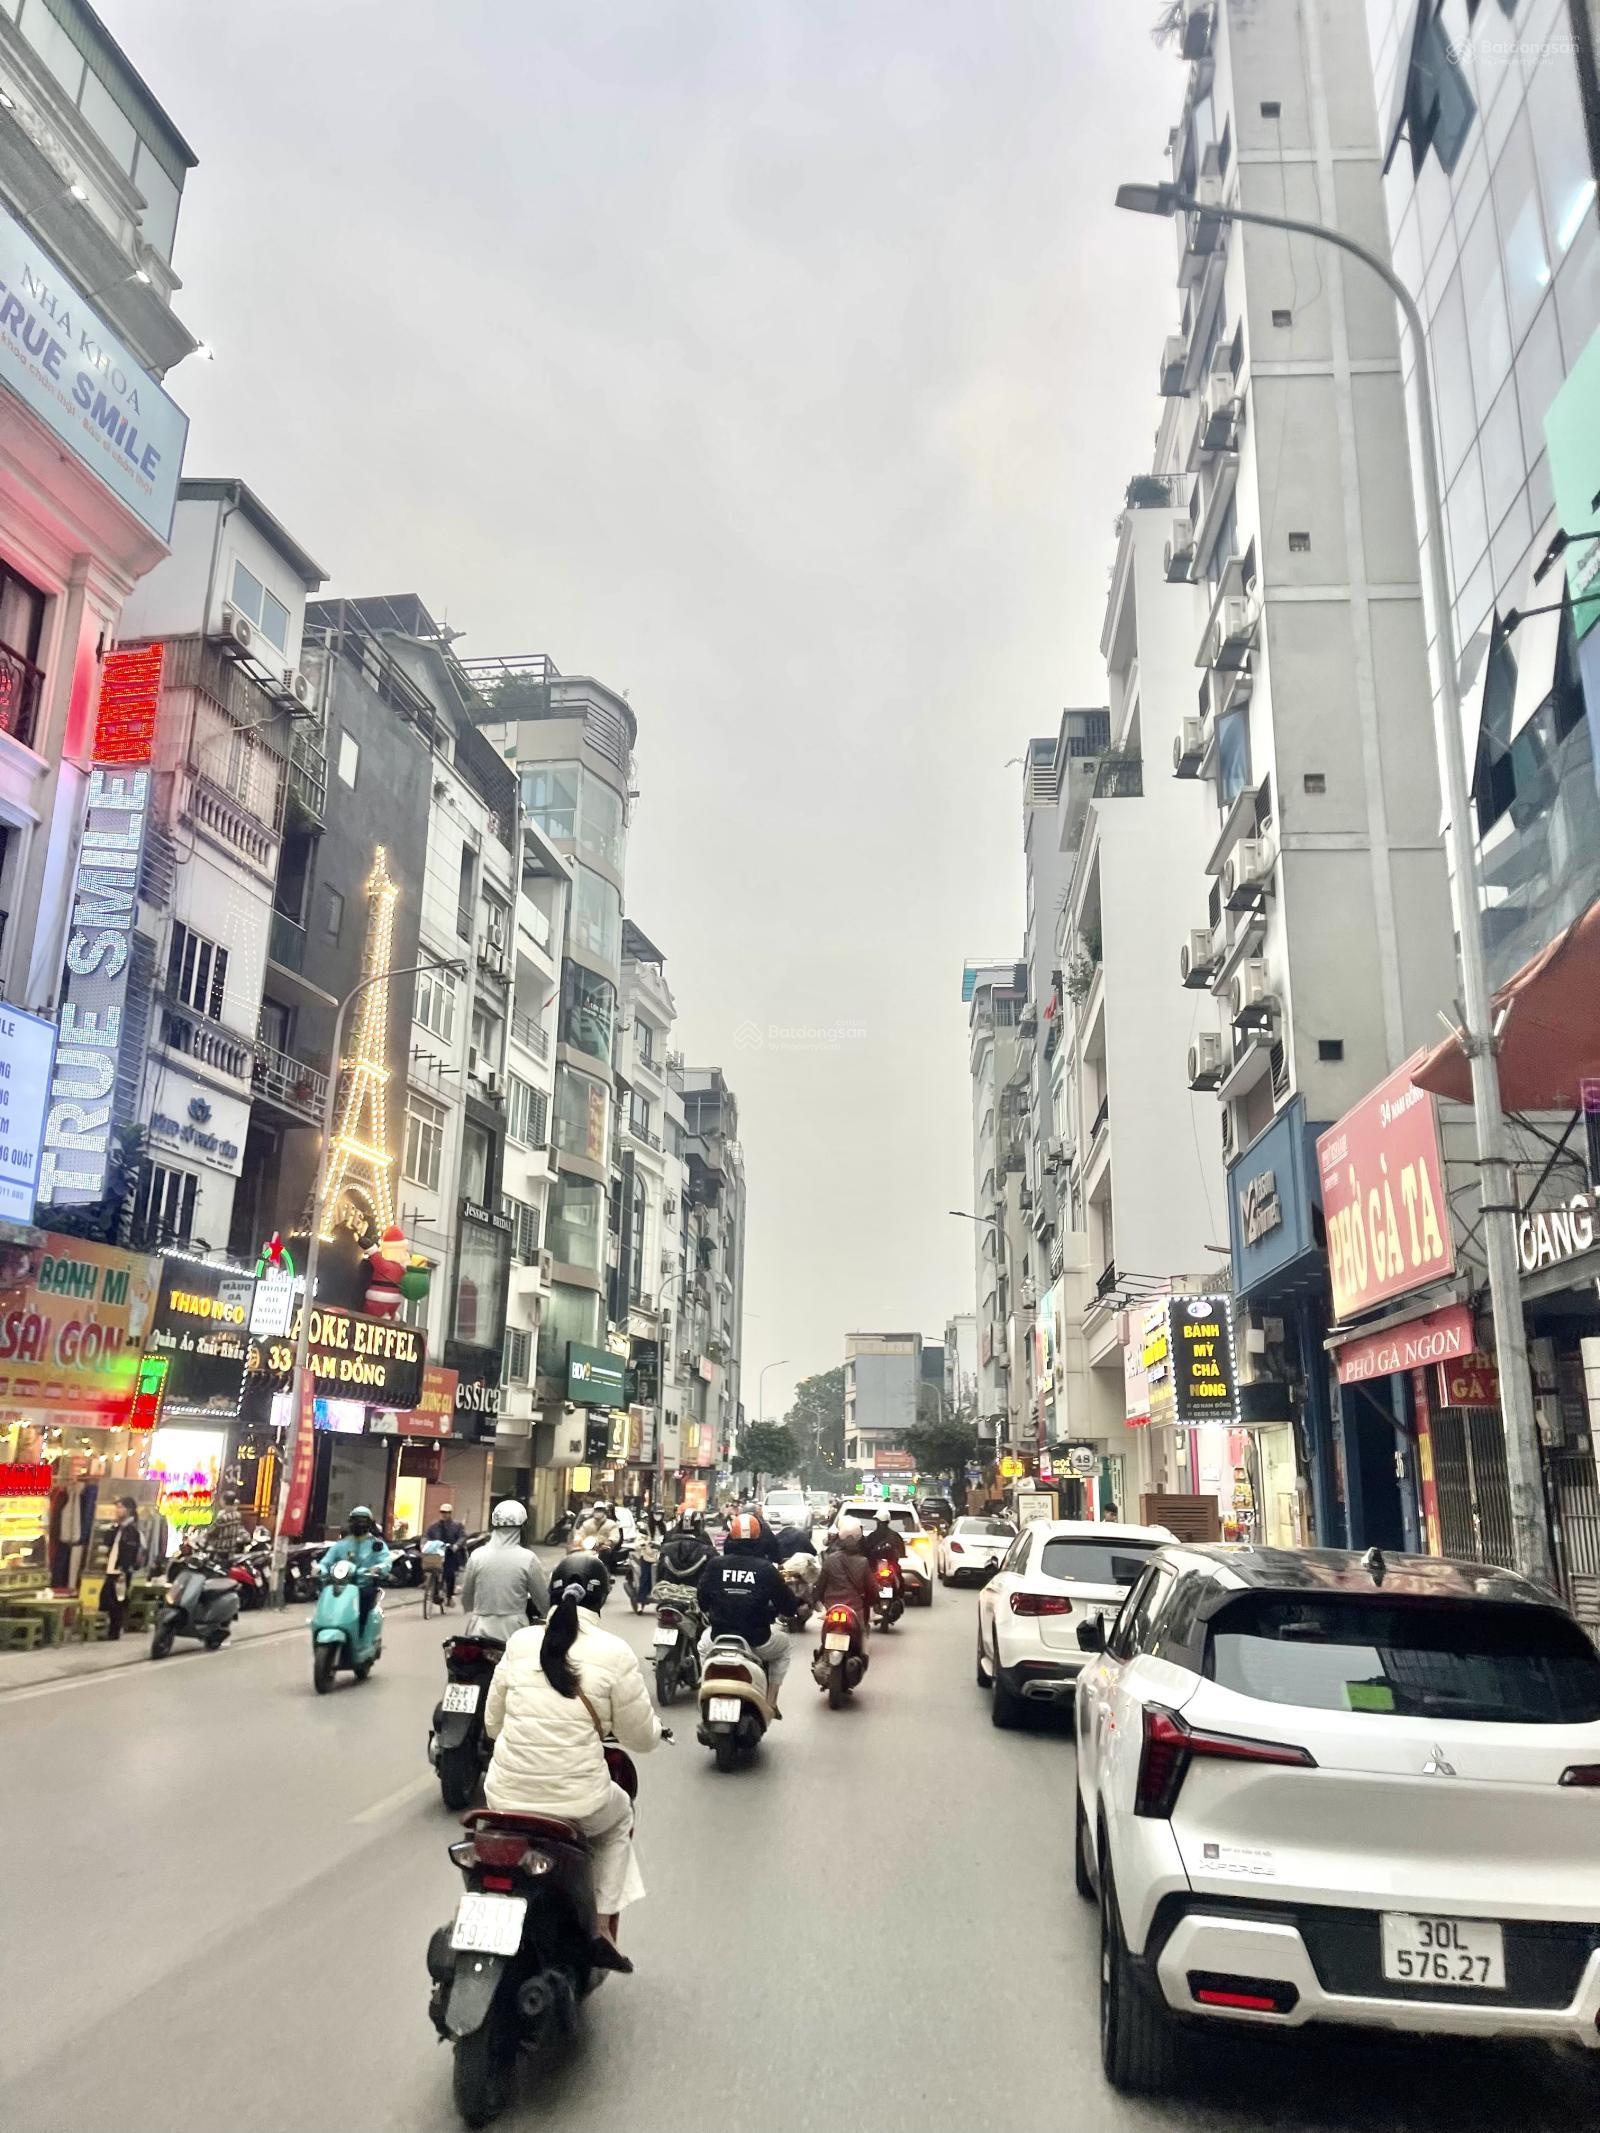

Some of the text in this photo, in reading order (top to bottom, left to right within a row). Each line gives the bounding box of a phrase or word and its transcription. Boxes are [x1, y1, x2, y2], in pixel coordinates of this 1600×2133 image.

[20, 262, 140, 416] NHA KHOA
[72, 371, 161, 481] SMILE
[37, 642, 163, 1203] TRUE SMILE DENTAL
[1329, 1163, 1367, 1298] PHỞ
[1369, 1152, 1404, 1283] GÀ
[1401, 1156, 1443, 1267] TA
[1511, 1193, 1594, 1271] OANG
[38, 1249, 98, 1301] BÁNH
[353, 1321, 418, 1363] EIFFEL
[1183, 1322, 1220, 1339] BÁNH
[268, 1345, 292, 1372] 33
[340, 1354, 386, 1387] ĐỒNG
[1192, 1359, 1220, 1377] CHẢ
[1346, 1327, 1462, 1382] PHỞ GÀ NGON
[1462, 1353, 1499, 1369] PH
[455, 1379, 500, 1414] essica
[1190, 1381, 1227, 1397] NÓNG
[1452, 1373, 1485, 1398] GÀ
[1075, 1454, 1090, 1464] 48
[722, 1569, 756, 1584] FIFA
[1418, 1921, 1468, 1950] 30L
[1397, 1949, 1491, 1983] 576.27
